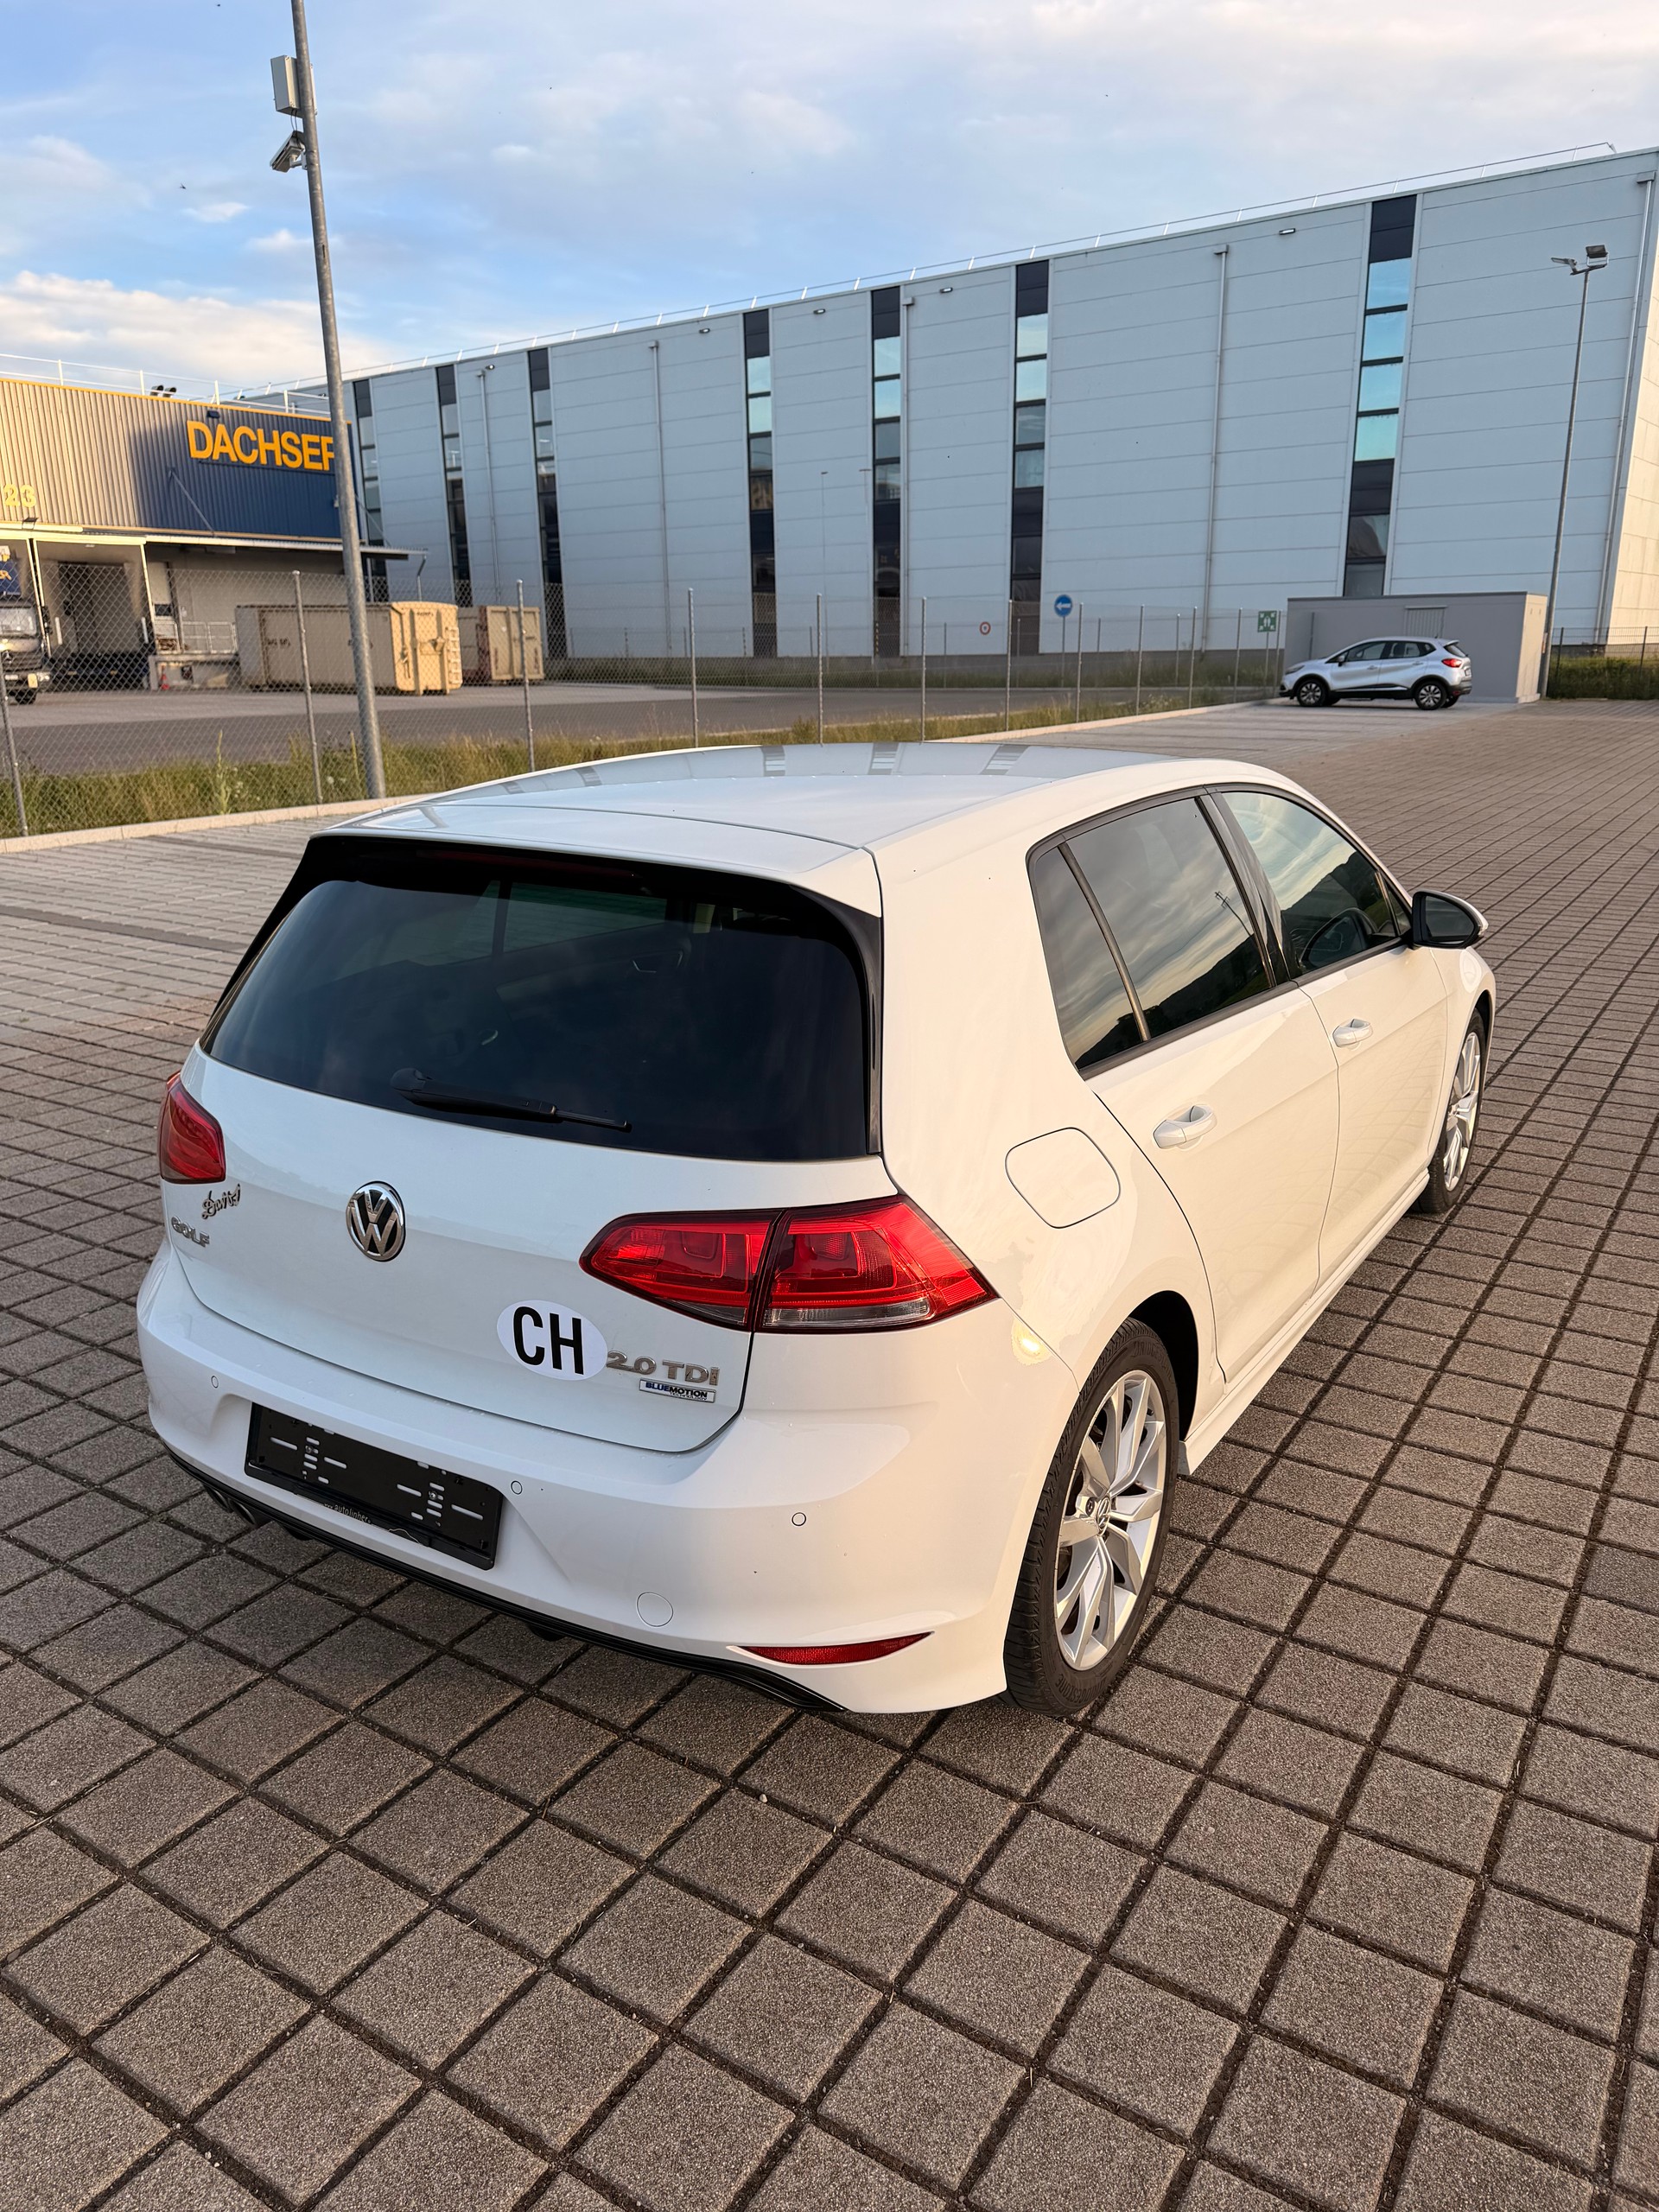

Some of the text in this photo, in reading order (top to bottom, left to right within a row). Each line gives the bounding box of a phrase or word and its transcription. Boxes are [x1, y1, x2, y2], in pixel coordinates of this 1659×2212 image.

[3, 484, 37, 508] 23
[171, 1216, 210, 1248] GOLF
[347, 1184, 403, 1259] VW
[512, 1306, 584, 1375] CH
[606, 1351, 720, 1386] 2.0 TDI
[645, 1381, 708, 1398] BLUEMOTION
